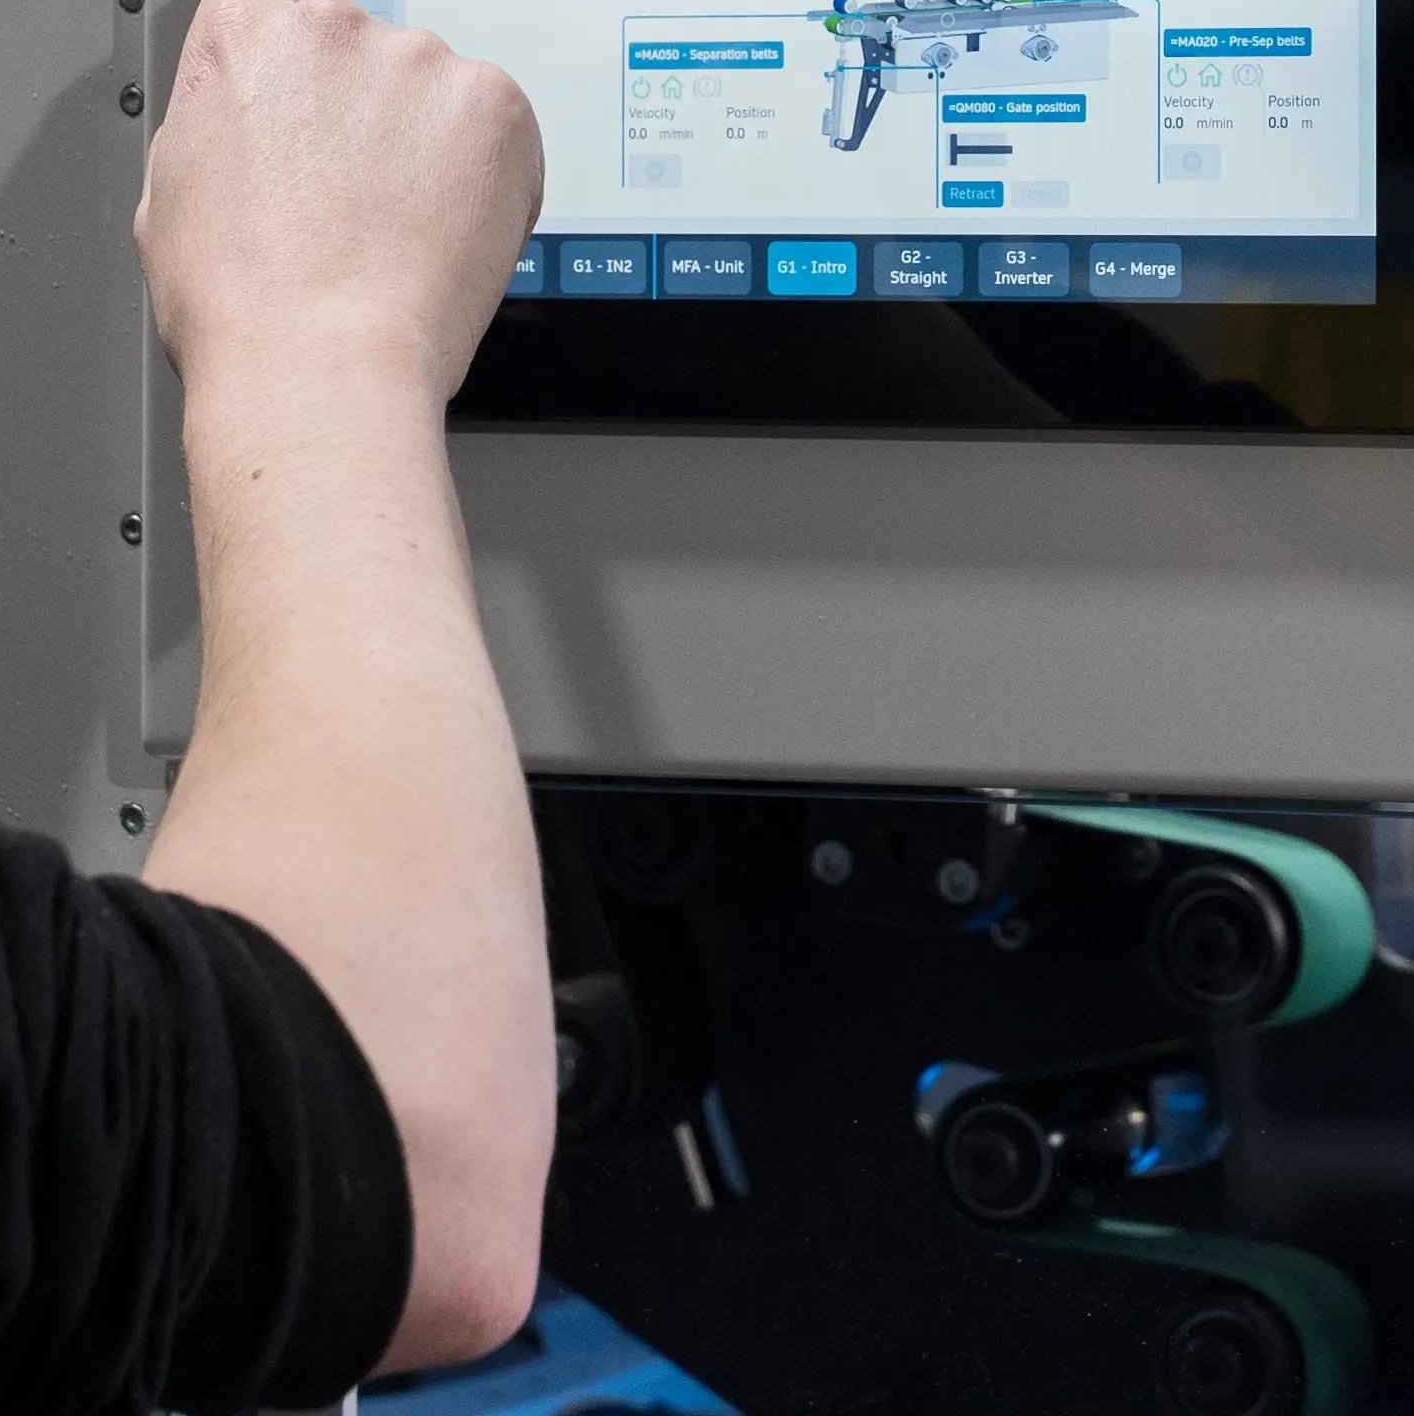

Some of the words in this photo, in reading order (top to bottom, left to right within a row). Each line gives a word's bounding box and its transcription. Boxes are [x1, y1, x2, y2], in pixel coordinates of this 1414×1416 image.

[1228, 35, 1274, 49] Pre-Sep
[1276, 35, 1306, 47] belts
[689, 48, 749, 63] Separation
[751, 48, 779, 61] belts
[1163, 95, 1215, 109] Velocity
[1267, 94, 1321, 107] Position
[628, 107, 676, 121] Velocity
[725, 106, 776, 119] Position
[1006, 102, 1033, 114] Gate
[1035, 101, 1081, 115] position
[1163, 116, 1184, 129] 0.0
[1196, 117, 1234, 129] m/min
[1267, 116, 1289, 129] 0.0
[1301, 118, 1313, 129] m
[628, 127, 648, 140] 0.0
[658, 127, 694, 140] m/min
[725, 127, 746, 140] 0.0
[756, 129, 769, 140] m
[949, 187, 996, 200] Retract
[900, 250, 921, 264] G2
[1005, 250, 1026, 264] G3
[513, 258, 536, 273] nit
[572, 258, 593, 273] G1
[606, 258, 634, 274] IN2
[671, 259, 701, 274] MFA
[714, 259, 745, 274] Unit
[777, 260, 796, 274] G1
[810, 260, 847, 275] Intro
[1094, 261, 1116, 276] G4
[1130, 261, 1177, 280] Merge
[889, 270, 948, 288] Straight
[994, 270, 1054, 285] Inverter
